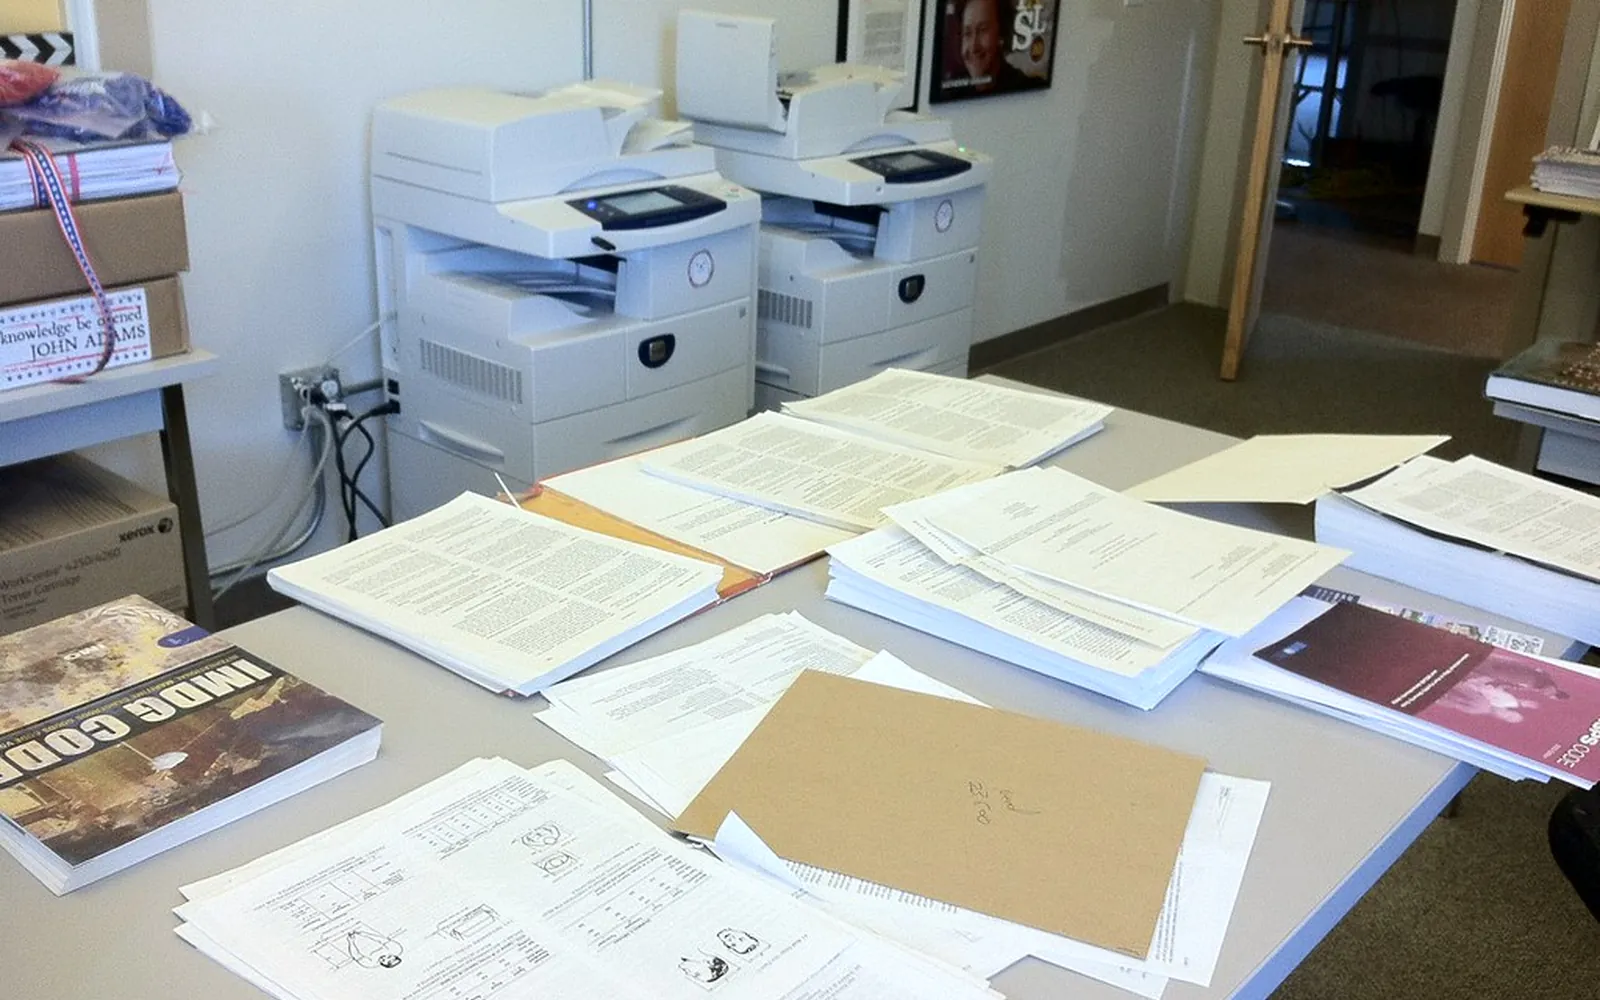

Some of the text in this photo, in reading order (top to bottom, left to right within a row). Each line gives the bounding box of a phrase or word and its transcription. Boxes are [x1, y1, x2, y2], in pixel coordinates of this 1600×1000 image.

[0, 306, 142, 345] knowledge be oened
[30, 337, 77, 361] JOHN
[119, 524, 155, 543] xerox
[122, 658, 272, 722] IMDG
[1556, 743, 1590, 768] CODE
